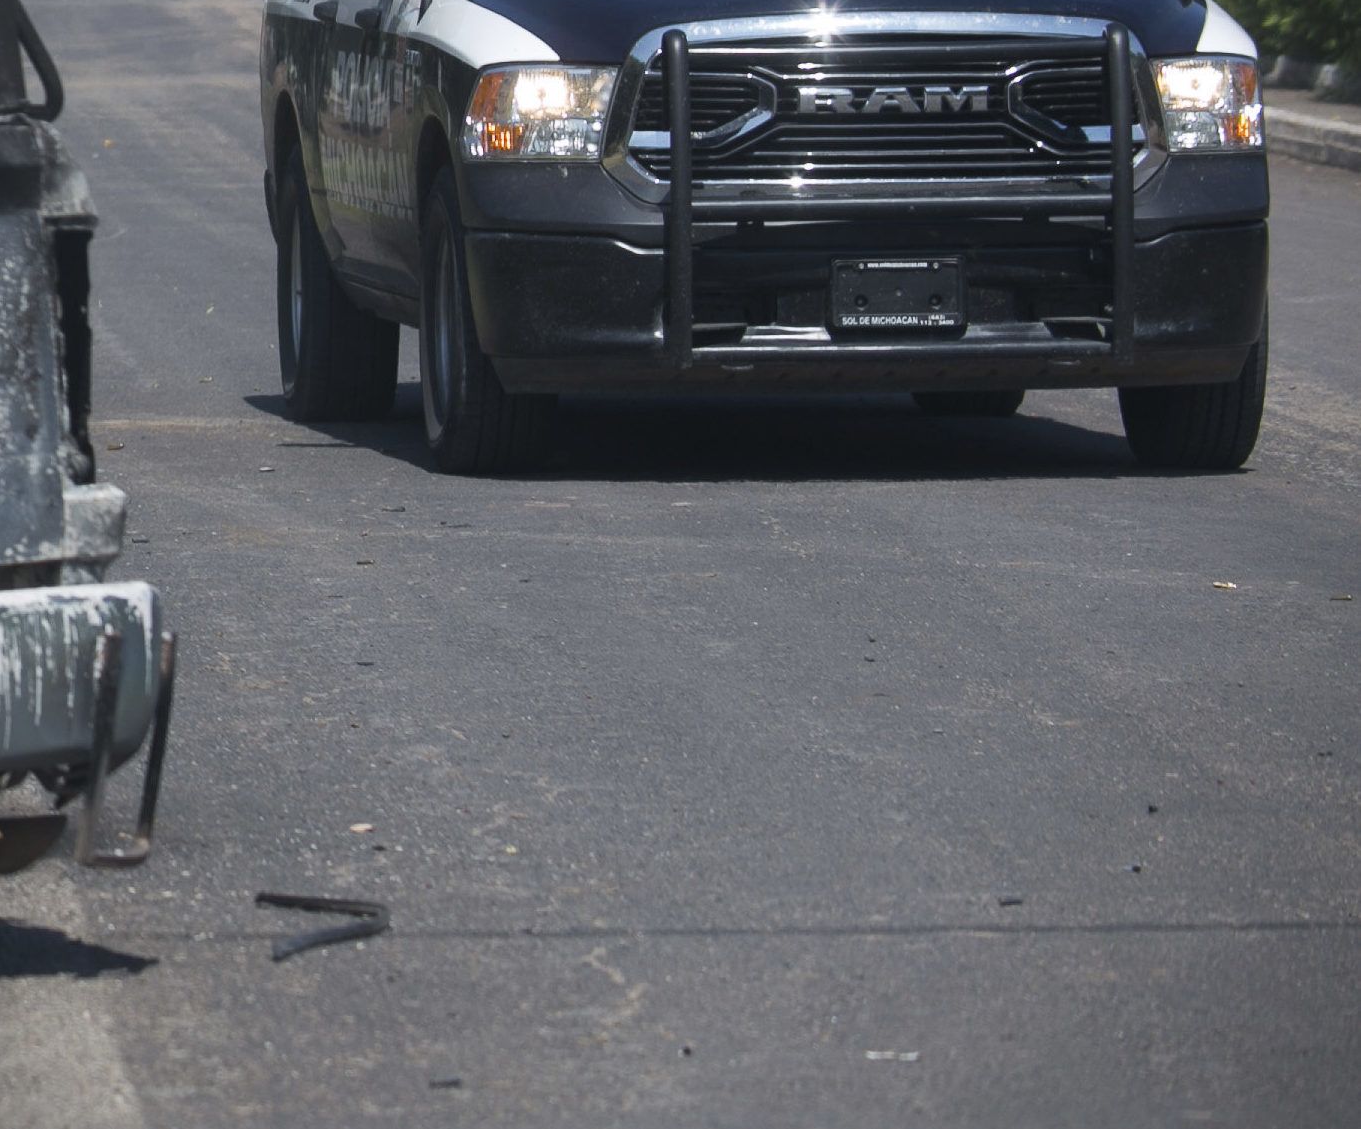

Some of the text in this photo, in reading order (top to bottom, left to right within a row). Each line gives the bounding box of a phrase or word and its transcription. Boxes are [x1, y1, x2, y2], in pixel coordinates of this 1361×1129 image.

[797, 85, 990, 114] RAM
[841, 315, 919, 326] SOL DE MICHOACAN
